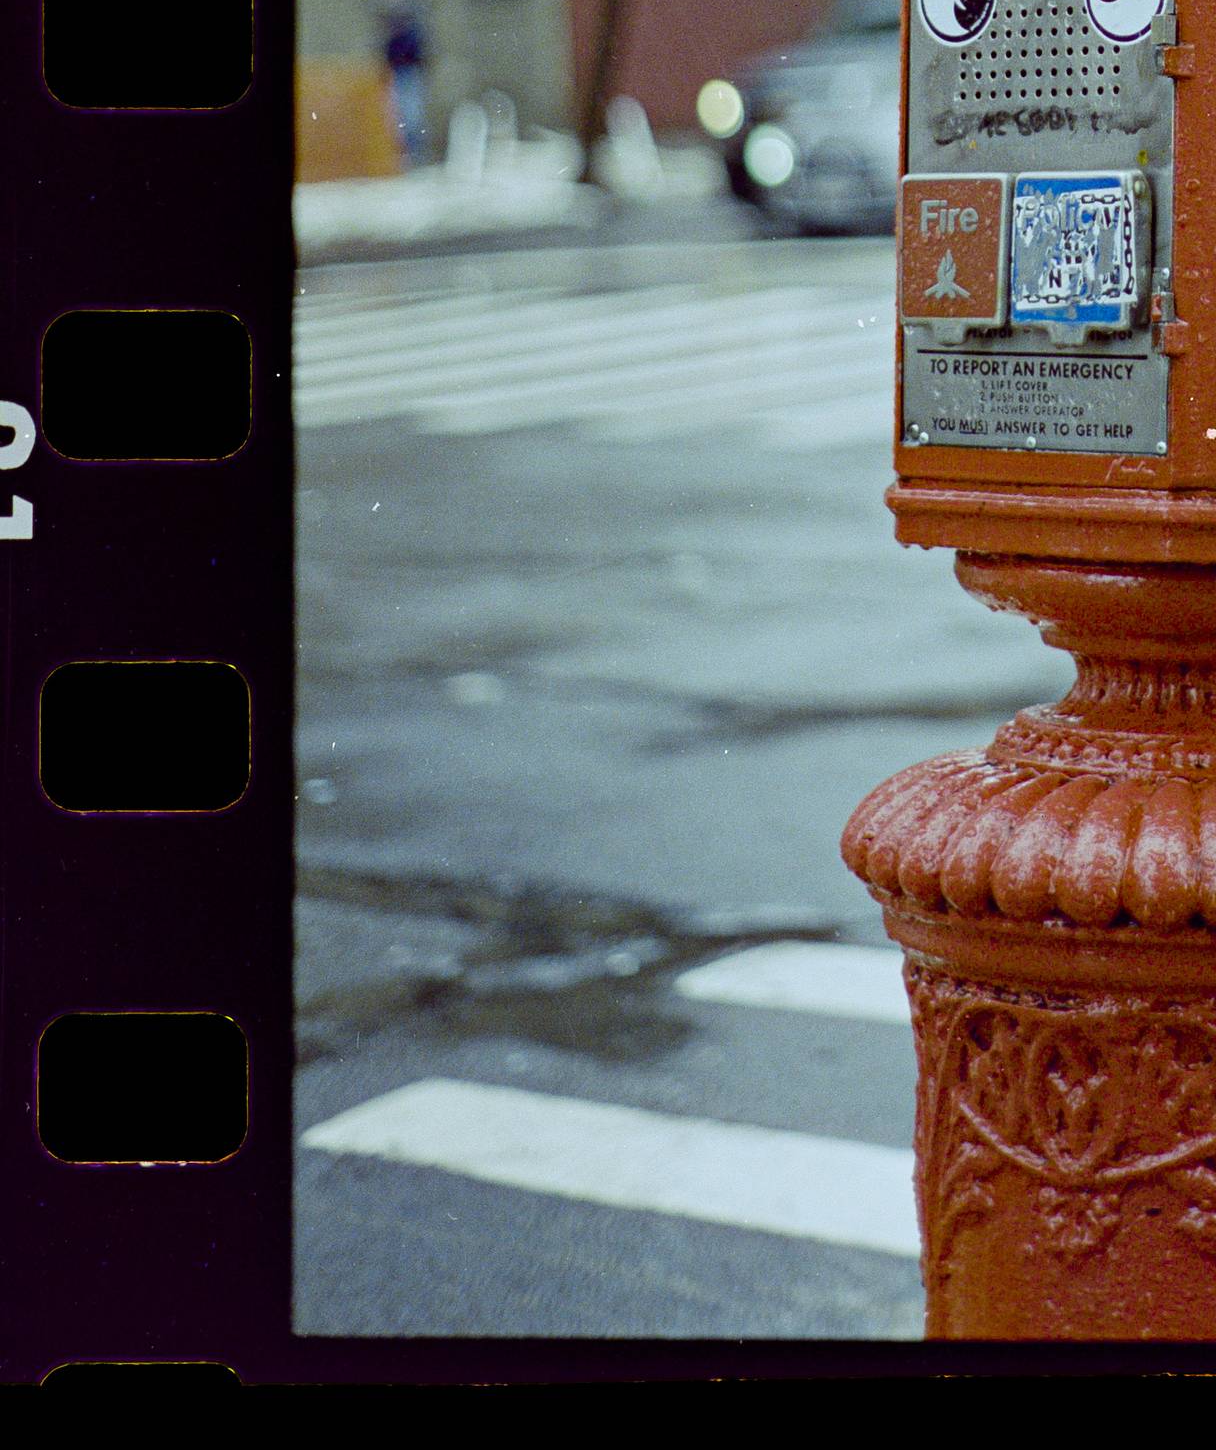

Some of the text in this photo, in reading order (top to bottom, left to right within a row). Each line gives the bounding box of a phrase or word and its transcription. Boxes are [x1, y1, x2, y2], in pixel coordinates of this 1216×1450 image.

[920, 199, 979, 236] Fire
[930, 359, 1134, 379] TO REPORT AN EMERGENCY
[1015, 380, 1048, 391] COVER
[1034, 405, 1084, 417] OPERATOR
[932, 417, 956, 431] YOU
[995, 420, 1046, 435] ANSWER
[1053, 422, 1069, 436] TO
[1076, 423, 1099, 437] GET
[1104, 423, 1133, 439] HELP
